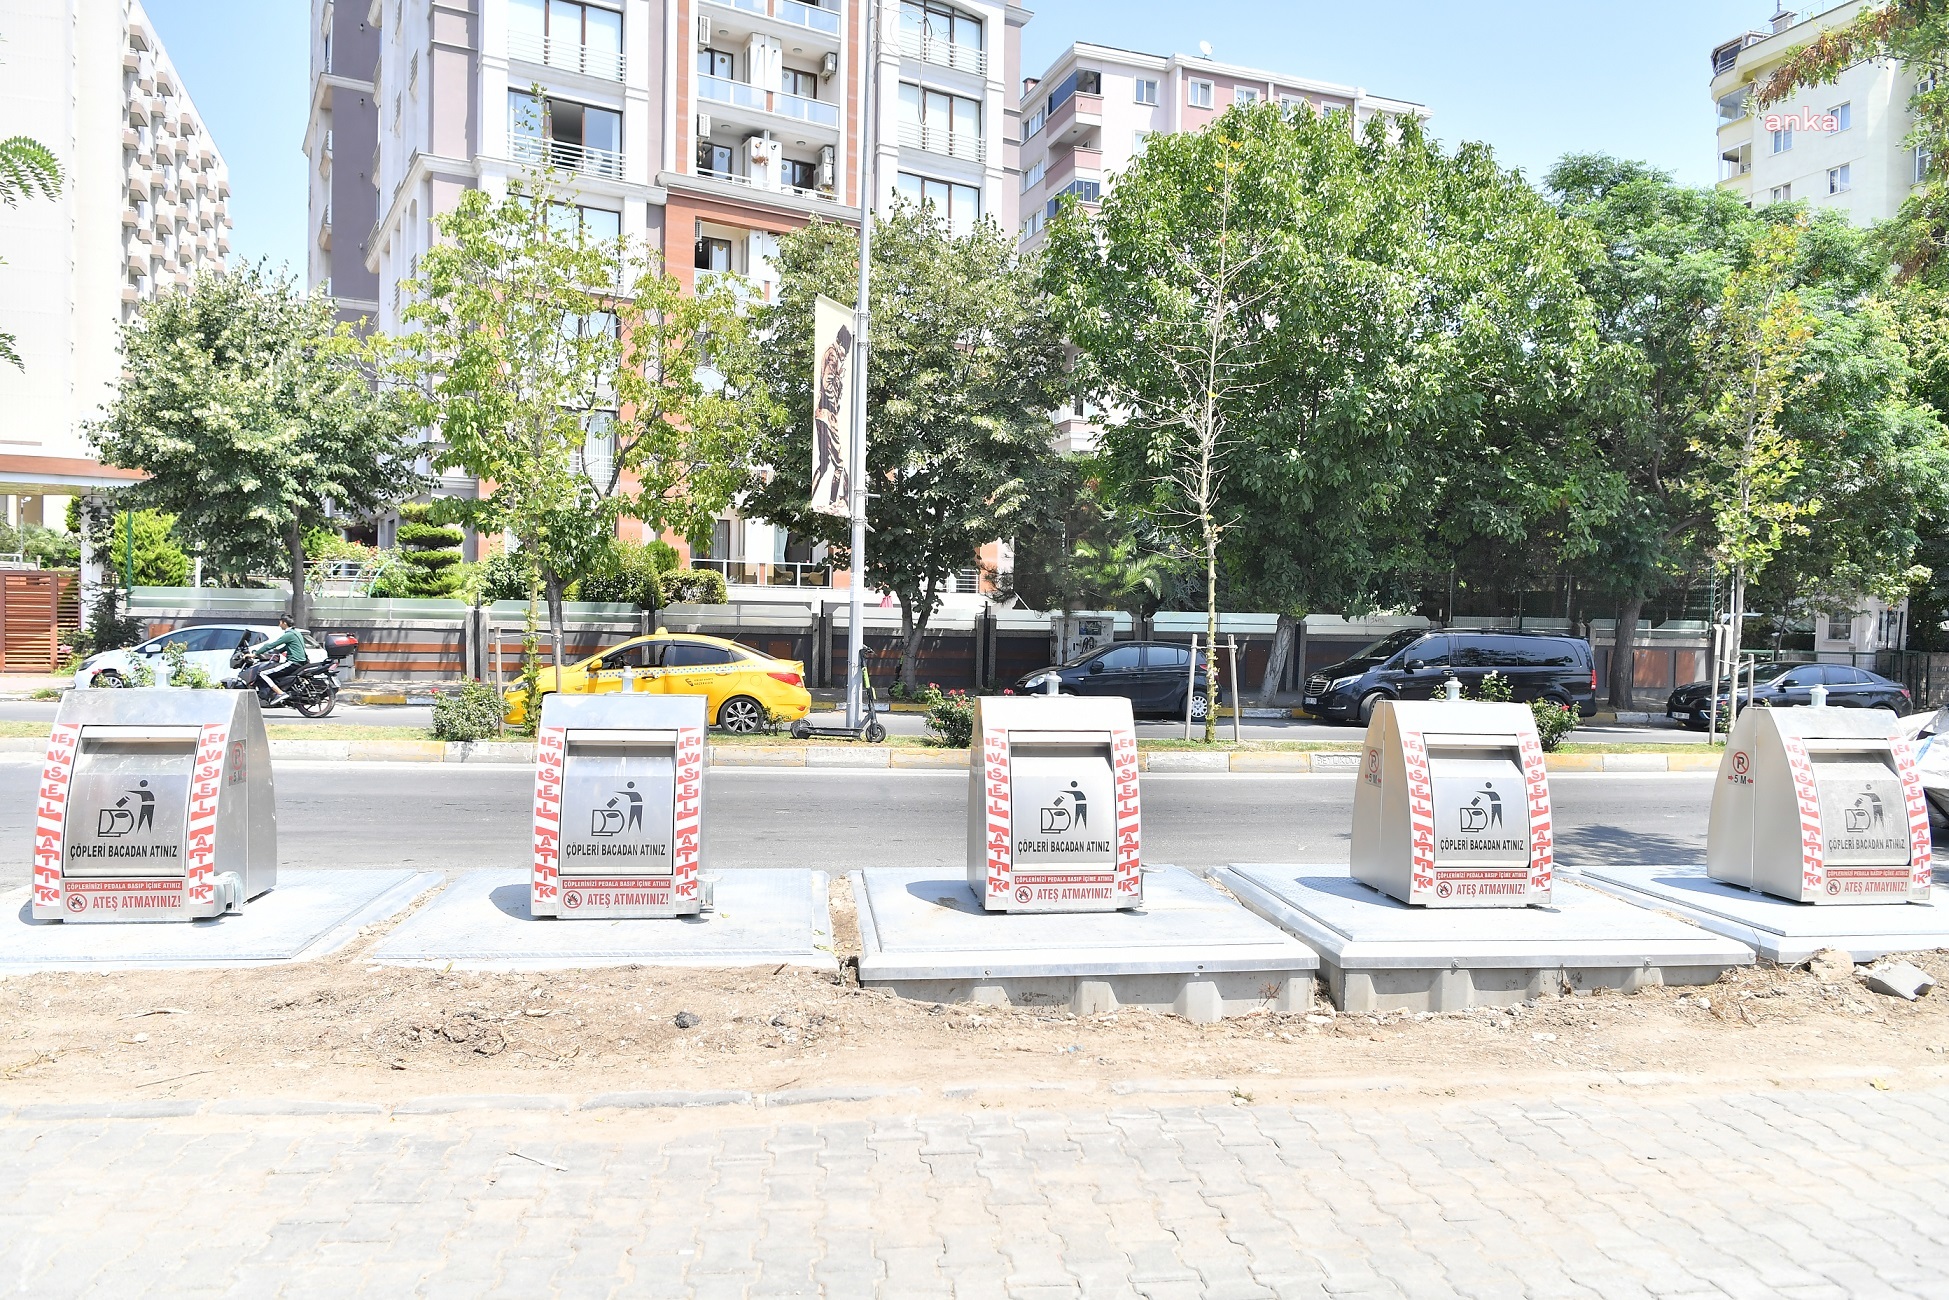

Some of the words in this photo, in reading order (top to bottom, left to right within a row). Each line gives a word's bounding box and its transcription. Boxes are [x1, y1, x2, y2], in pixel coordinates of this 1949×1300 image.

[46, 734, 69, 812] EVSEL
[200, 734, 218, 811] EVSEL
[543, 737, 556, 812] EVSEL
[684, 737, 695, 811] EVSEL
[992, 738, 1002, 810] EVSEL
[1120, 738, 1132, 811] EVSEL
[1740, 776, 1746, 784] M
[1410, 741, 1425, 810] EVSEL
[1418, 832, 1428, 888] ATIK
[1526, 741, 1543, 809] EVSEL
[1536, 831, 1546, 887] ATIK
[1792, 745, 1813, 810] EVSEL
[1808, 832, 1817, 886] ATIK
[1898, 745, 1921, 809] EVSEL
[1917, 831, 1925, 884] ATIK
[41, 837, 54, 901] ATIK
[71, 843, 105, 860] ÇÖPLERİ
[109, 846, 147, 857] BACADAN
[150, 846, 177, 857] ATINIZ
[195, 836, 207, 899] ATIK
[540, 836, 551, 897] ATIK
[567, 842, 599, 858] ÇÖPLERİ
[602, 845, 638, 855] BACADAN
[640, 845, 665, 855] ATINIZ
[681, 835, 693, 895] ATIK
[993, 833, 1004, 892] ATIK
[1018, 839, 1048, 855] ÇÖPLERİ
[1051, 841, 1084, 852] BACADAN
[1087, 841, 1109, 852] ATINIZ
[1123, 834, 1133, 891] ATIK
[1441, 837, 1468, 853] ÇÖPLERİ
[1470, 840, 1500, 850] BACADAN
[1502, 840, 1523, 850] ATINIZ
[1829, 837, 1854, 852] ÇÖPLERİ
[1856, 840, 1883, 849] BACADAN
[1886, 839, 1905, 848] ATINIZ
[67, 883, 102, 891] ÇÖPLERİNİZİ
[93, 896, 117, 911] ATEŞ
[122, 896, 181, 908] ATMAYINIZ!
[587, 894, 610, 908] ATEŞ
[614, 893, 668, 905] ATMAYINIZ!
[1037, 889, 1058, 902] ATEŞ
[1062, 888, 1112, 899] ATMAYINIZ!
[1457, 884, 1476, 897] ATEŞ
[1479, 884, 1525, 894] ATMAYINIZ!
[1845, 882, 1862, 895] ATEŞ
[1865, 882, 1907, 892] ATMAYINIZ!
